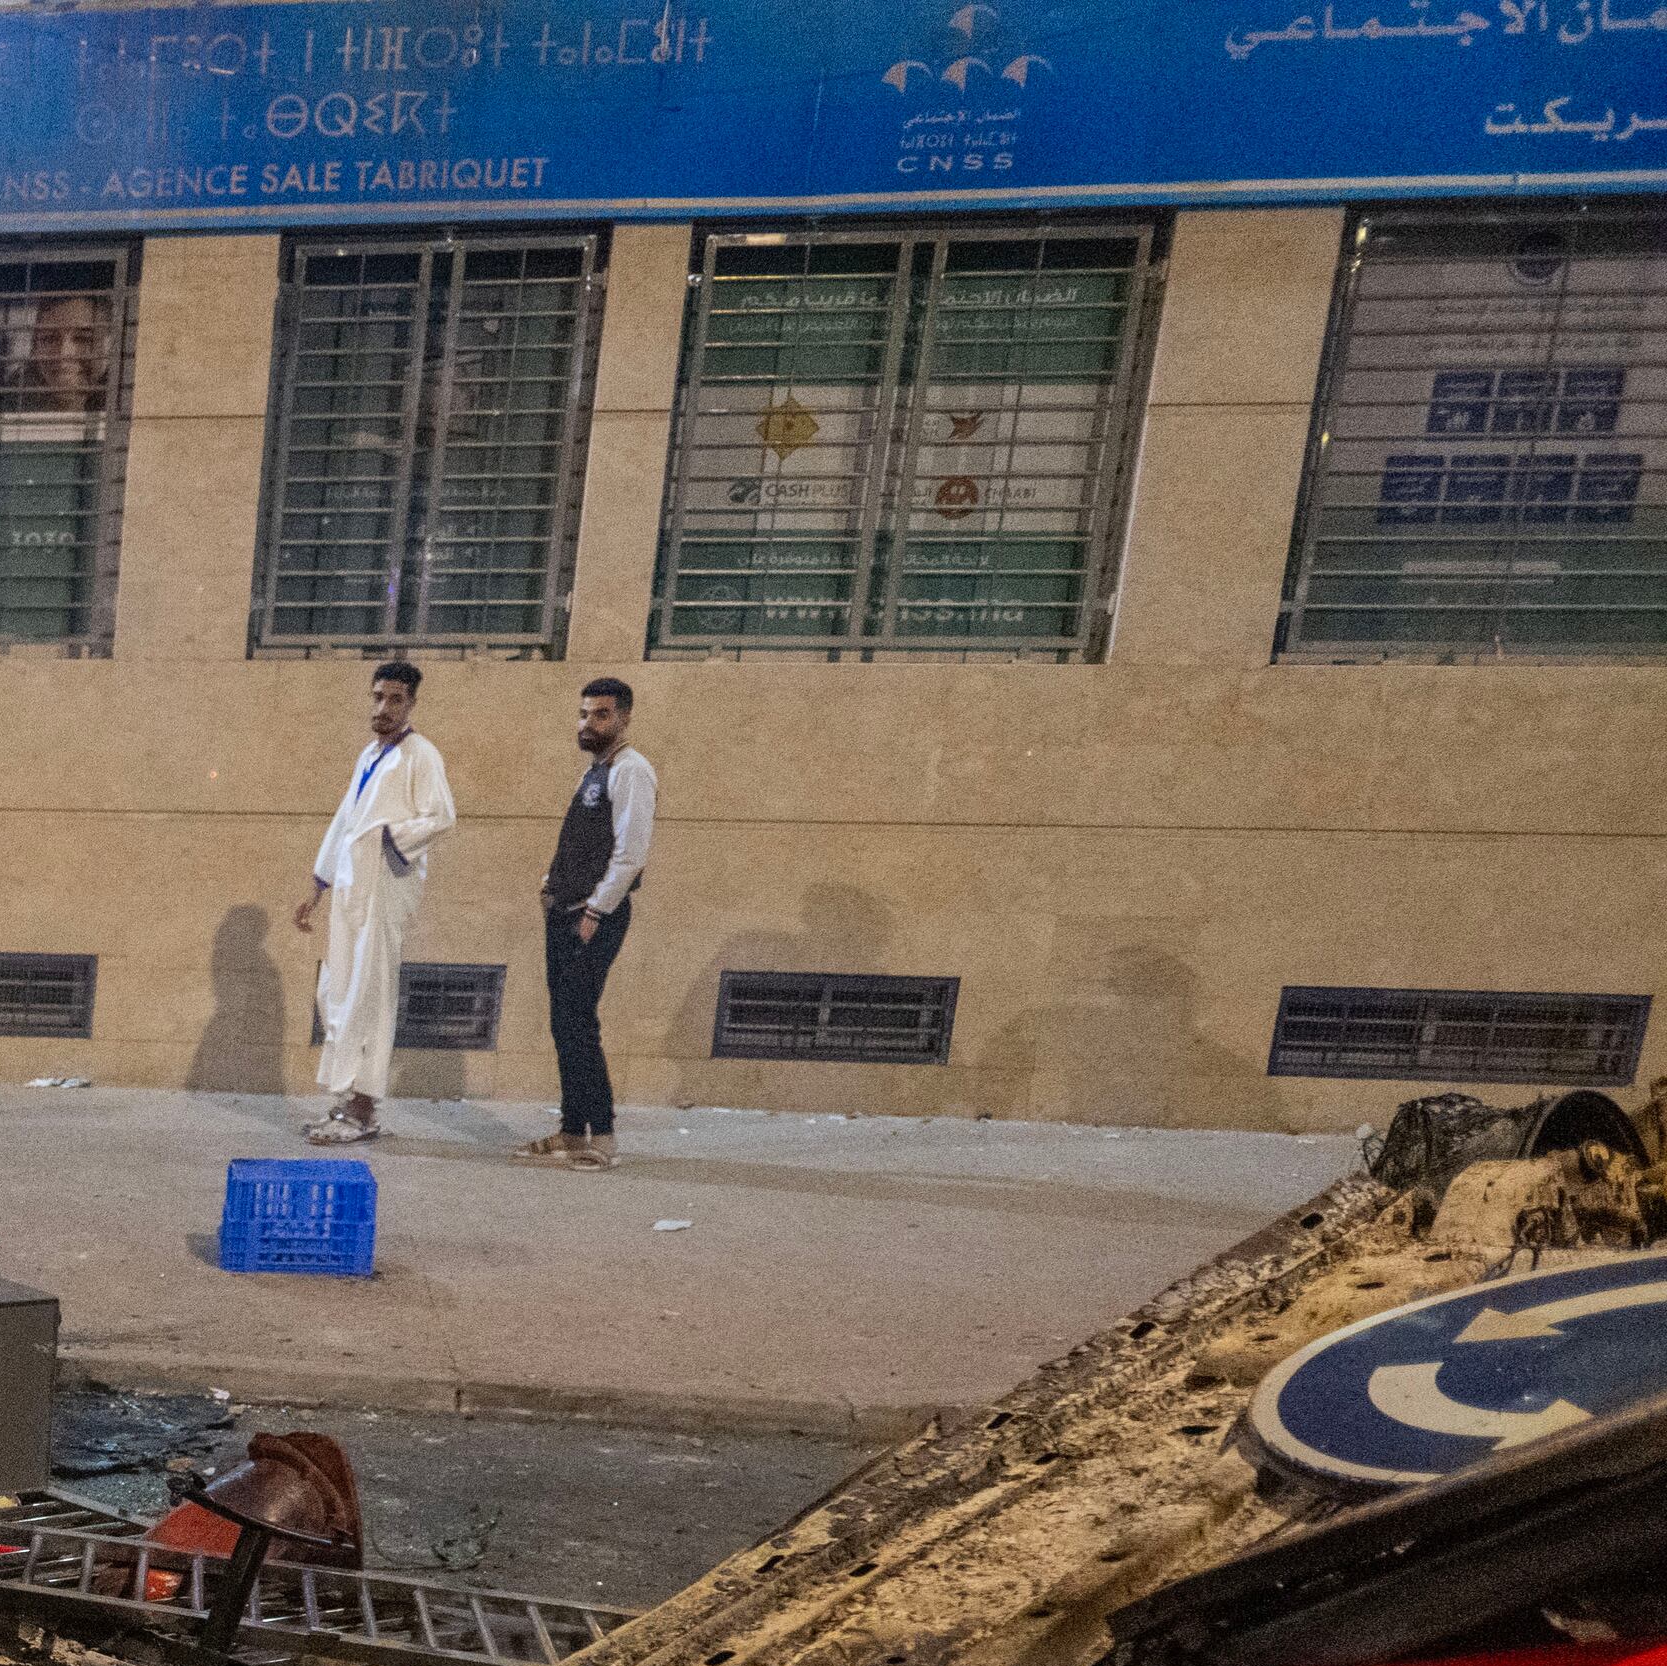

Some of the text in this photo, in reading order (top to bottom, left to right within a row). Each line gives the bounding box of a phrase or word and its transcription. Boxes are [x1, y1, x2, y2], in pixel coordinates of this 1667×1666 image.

[100, 166, 248, 200] AGENCE
[260, 161, 341, 194] SALE
[355, 156, 549, 193] TABRIQUET
[897, 152, 1014, 173] CNSS
